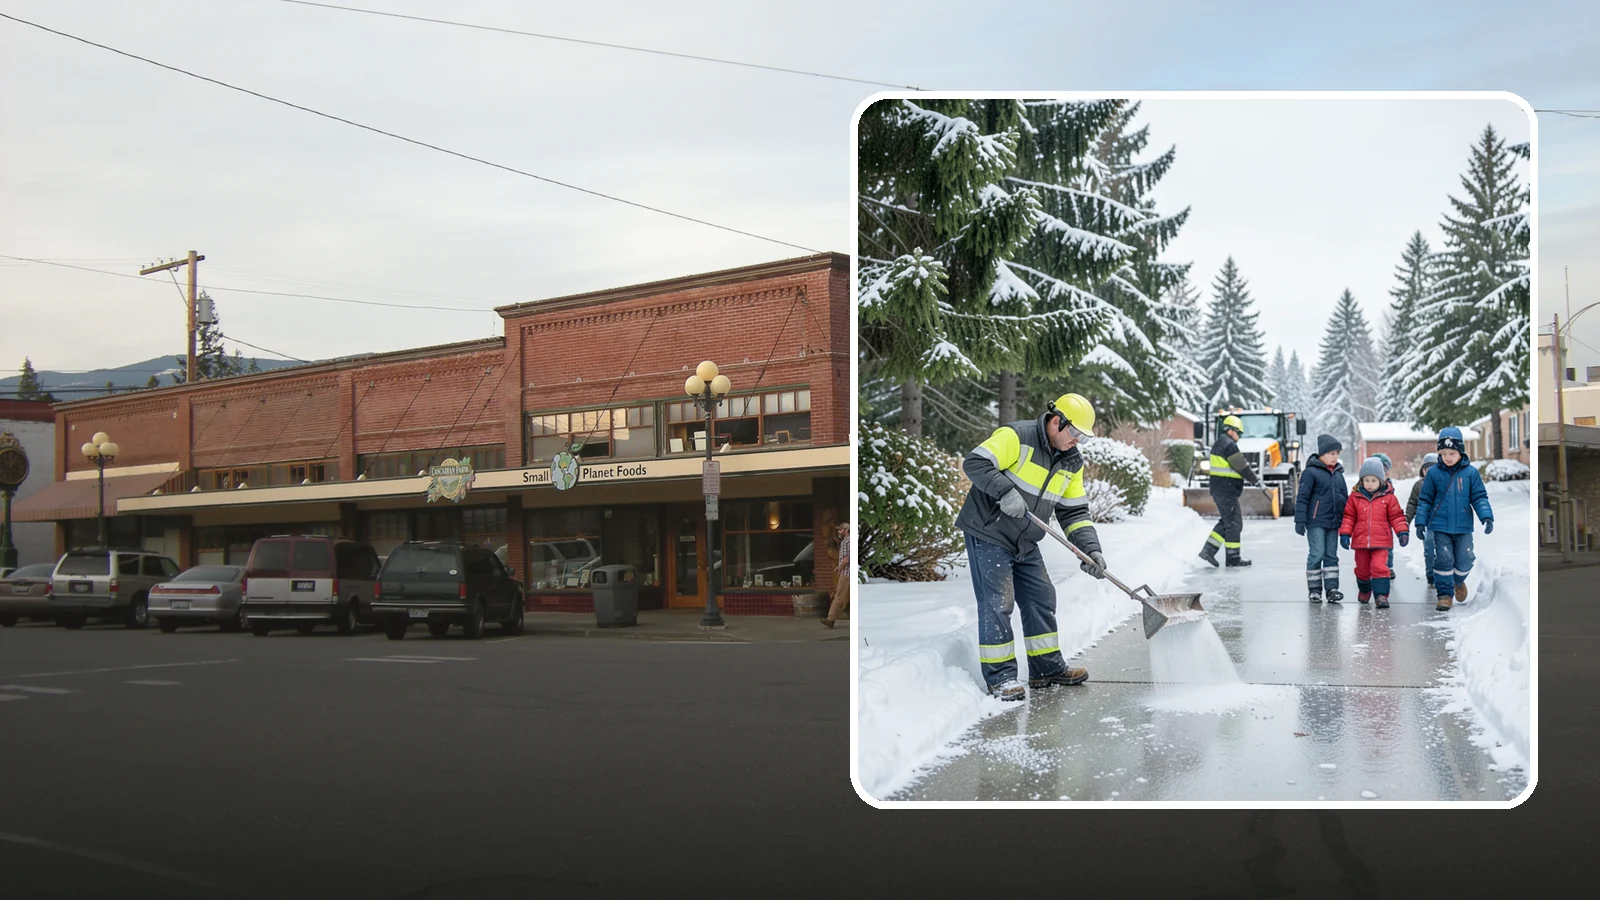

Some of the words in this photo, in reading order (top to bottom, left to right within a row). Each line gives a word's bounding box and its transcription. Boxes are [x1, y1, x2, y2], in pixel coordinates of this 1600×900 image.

[523, 471, 549, 483] Small
[583, 467, 614, 479] Planet
[617, 464, 647, 477] Foods
